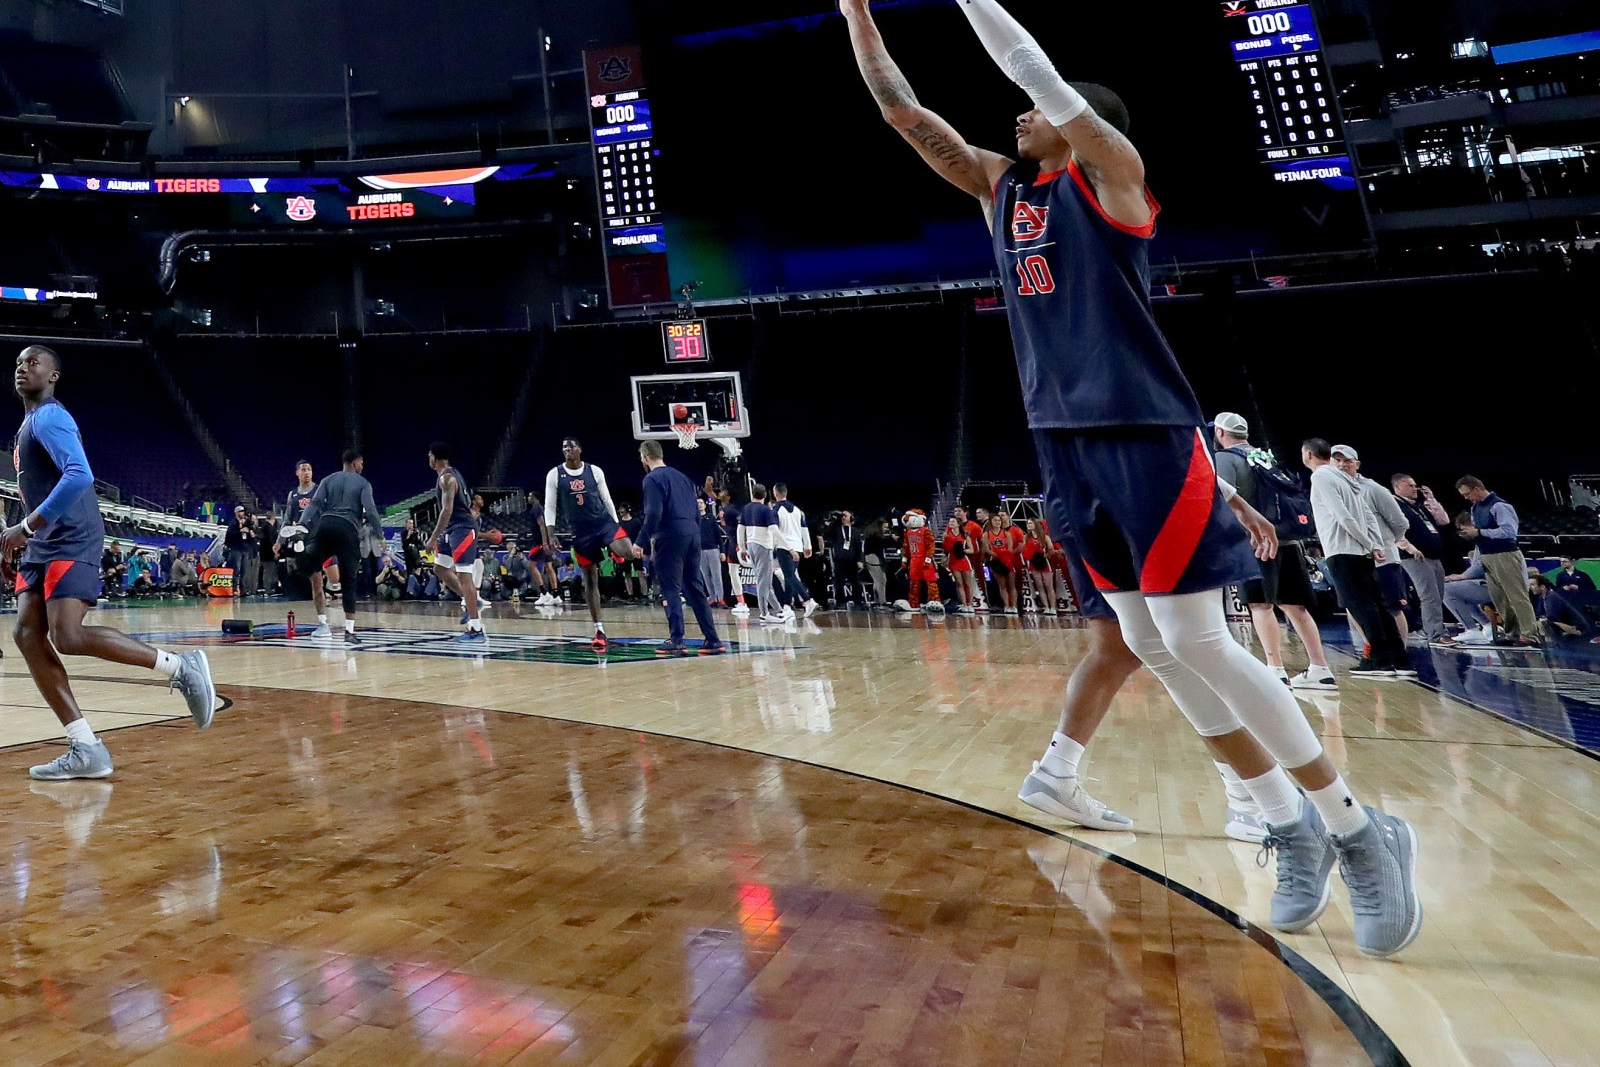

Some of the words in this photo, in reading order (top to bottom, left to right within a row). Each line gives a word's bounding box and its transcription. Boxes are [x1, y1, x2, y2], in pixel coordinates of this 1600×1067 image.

[1247, 11, 1290, 35] 000
[1235, 38, 1272, 51] BONUS
[1240, 62, 1258, 71] PLYR
[1267, 59, 1282, 68] PTS
[1286, 57, 1299, 66] AST
[1304, 54, 1318, 63] FLS
[1249, 75, 1256, 85] 1
[1273, 72, 1282, 81] 0
[1291, 69, 1300, 79] 0
[1310, 67, 1318, 77] 0
[1252, 89, 1260, 100] 2
[1277, 86, 1286, 96] 0
[1295, 84, 1304, 94] 0
[1314, 82, 1322, 92] 0
[606, 104, 635, 124] 000
[1256, 104, 1264, 114] 3
[1281, 101, 1290, 111] 0
[1299, 99, 1308, 109] 0
[1318, 97, 1326, 107] 0
[1260, 119, 1268, 129] 4
[1285, 117, 1293, 127] 0
[1303, 115, 1312, 124] 0
[1322, 112, 1330, 122] 0
[1263, 134, 1272, 145] 5
[1289, 132, 1297, 142] 0
[1307, 130, 1316, 140] 0
[1326, 128, 1334, 138] 0
[1267, 149, 1289, 159] FOULS
[1306, 146, 1321, 154] TOL
[1274, 166, 1342, 182] #FINALFOUR
[107, 180, 150, 191] AUBURN
[154, 178, 220, 193] TIGERS
[357, 192, 402, 205] AUBURN
[346, 202, 415, 221] TIGERS
[1016, 254, 1055, 296] 10
[668, 324, 701, 338] 30:22
[674, 336, 700, 359] 30
[575, 493, 584, 506] 3
